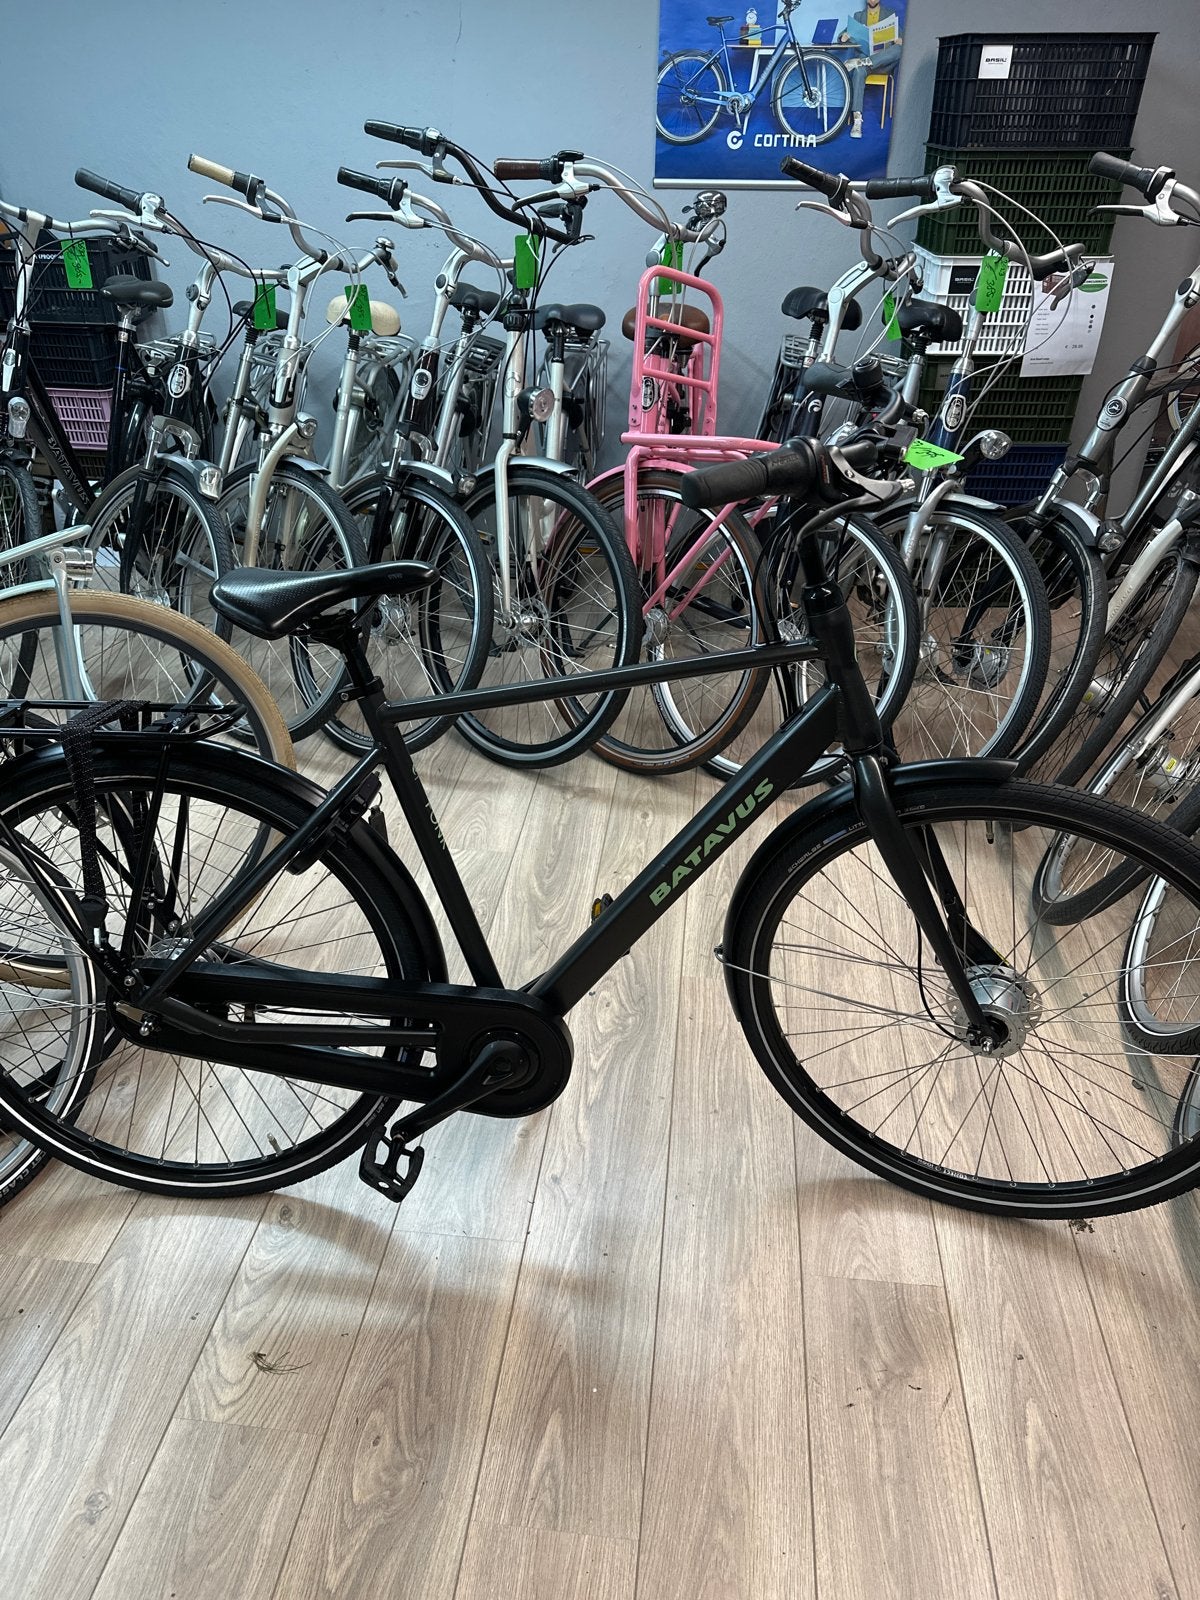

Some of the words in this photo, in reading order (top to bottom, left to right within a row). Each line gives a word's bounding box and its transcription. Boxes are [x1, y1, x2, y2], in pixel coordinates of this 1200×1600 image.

[753, 133, 817, 148] CORTINA
[649, 777, 775, 908] BATAVUS
[787, 843, 823, 874] SCHWALBE
